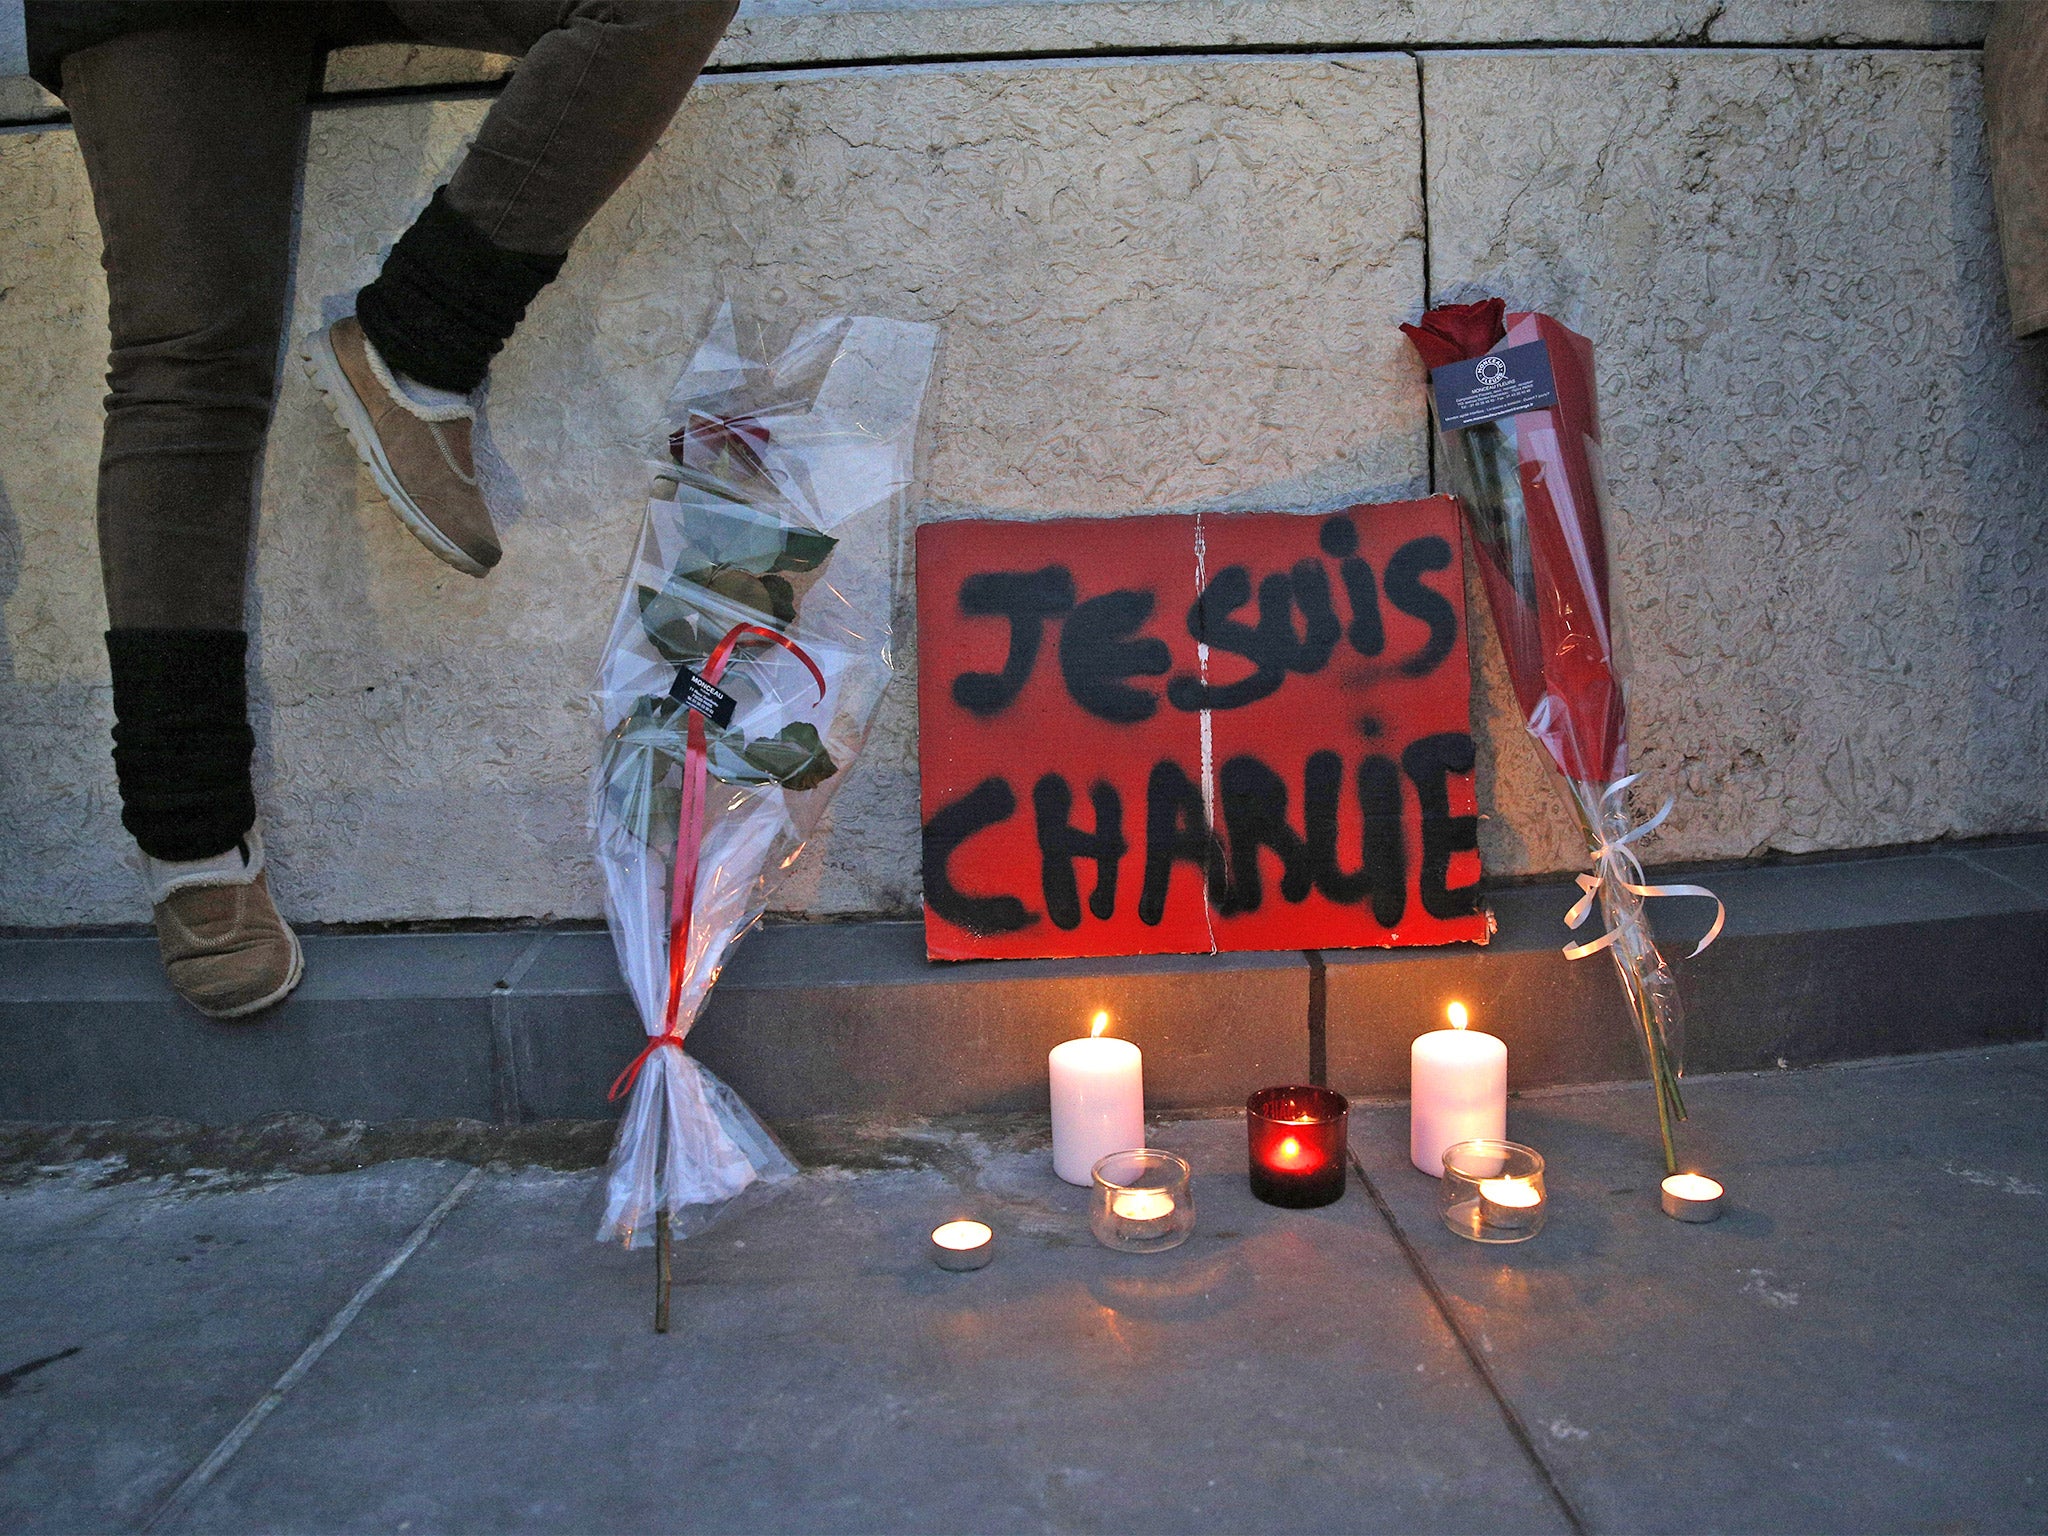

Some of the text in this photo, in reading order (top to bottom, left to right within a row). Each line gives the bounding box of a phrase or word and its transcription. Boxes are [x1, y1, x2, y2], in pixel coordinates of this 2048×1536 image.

[1477, 358, 1504, 374] MONCEAU
[1481, 372, 1503, 383] FLEURS
[1471, 384, 1497, 394] MONCEAU
[1496, 378, 1516, 388] FLEURS
[691, 676, 723, 699] MONCEAU
